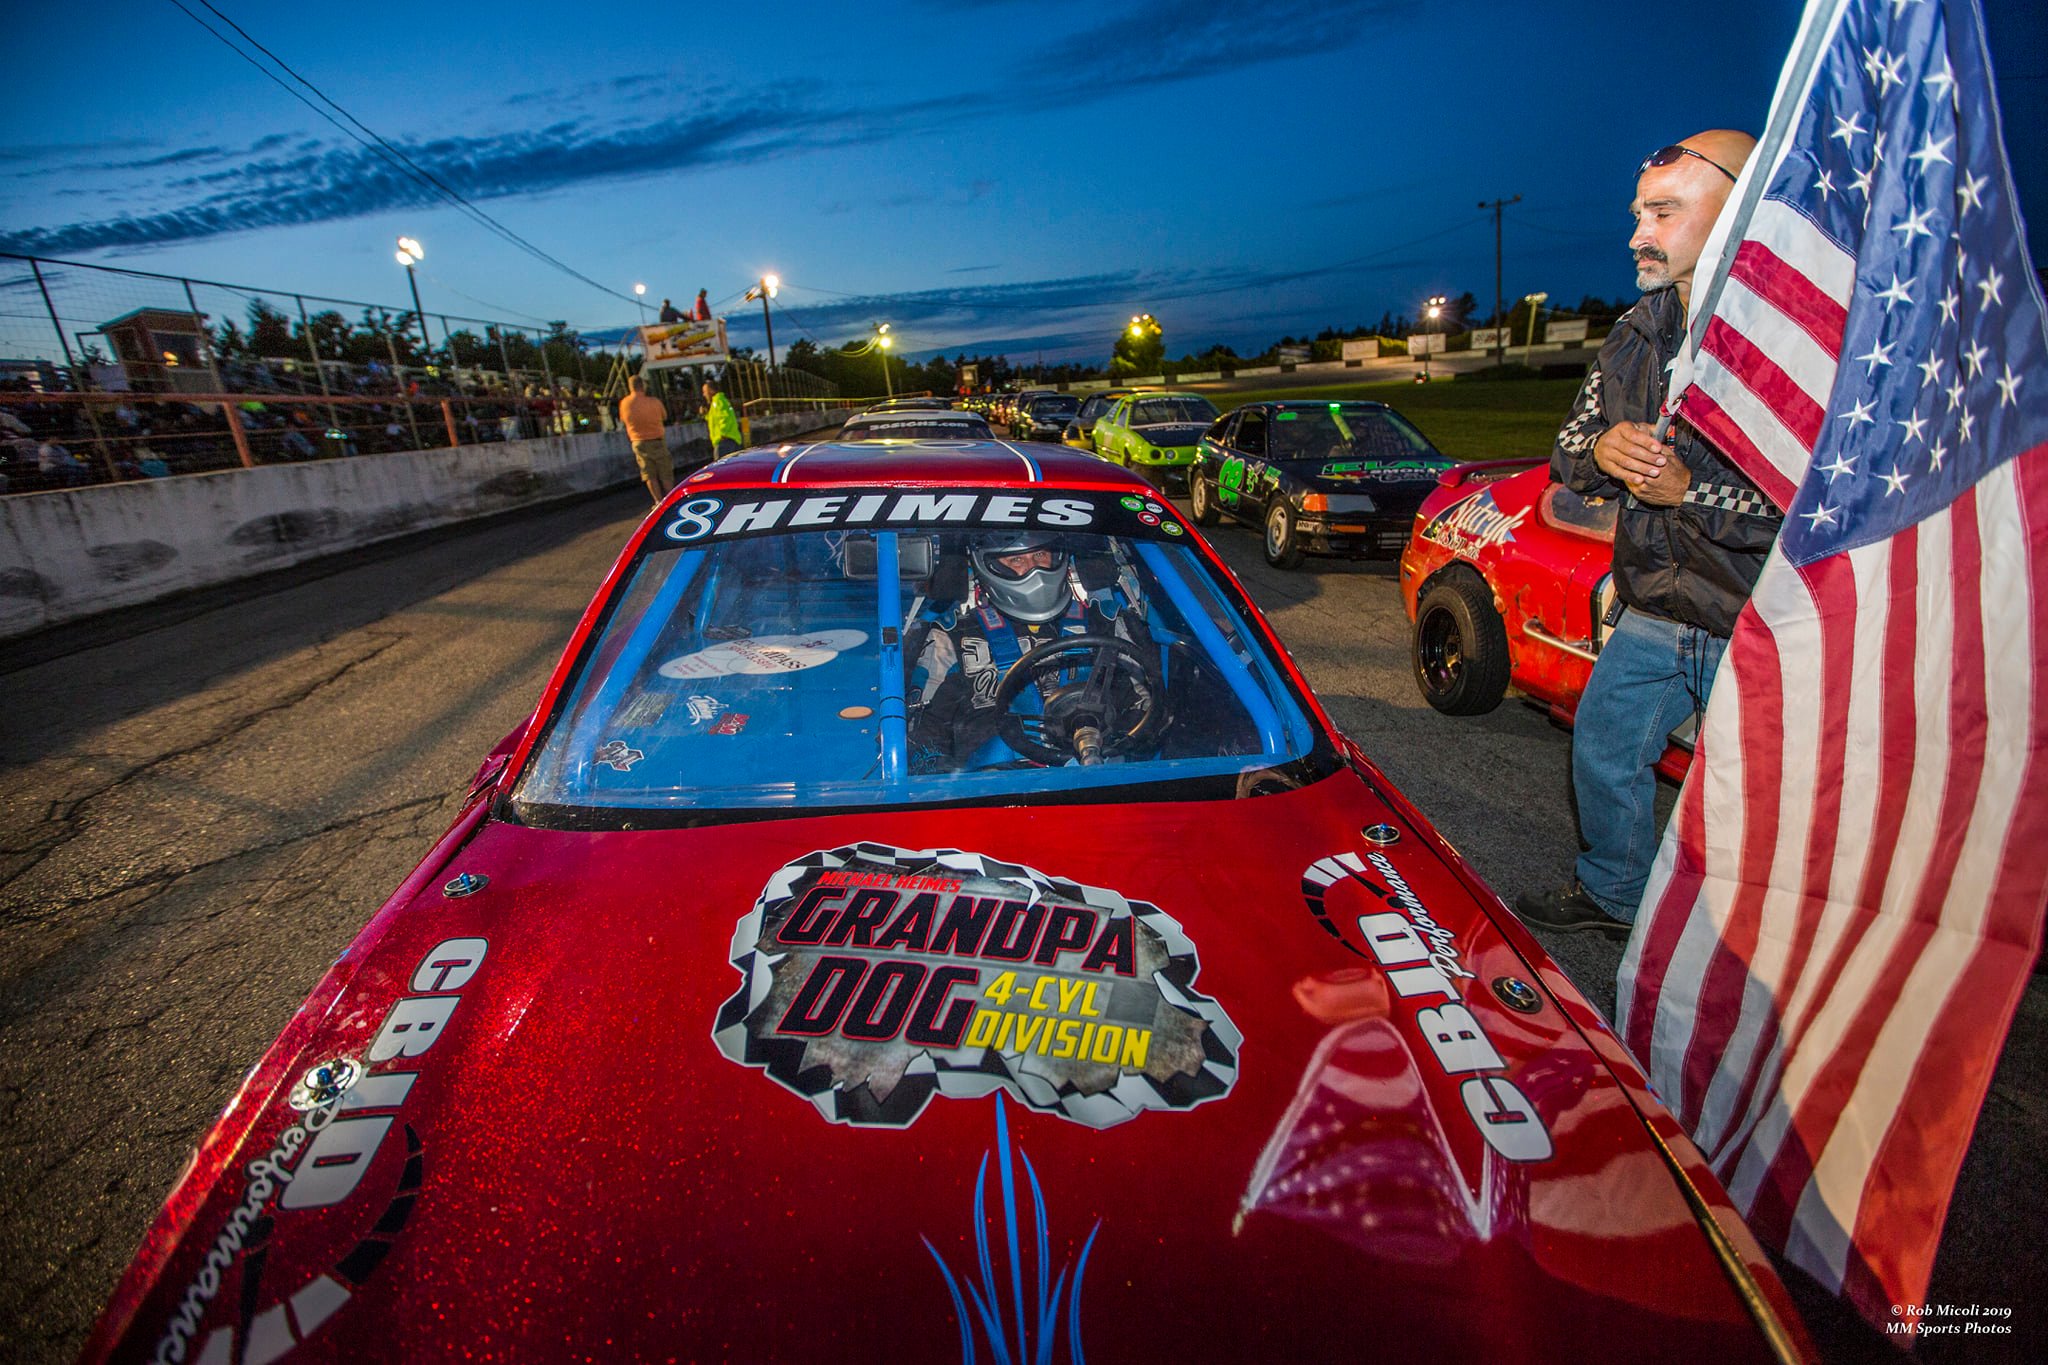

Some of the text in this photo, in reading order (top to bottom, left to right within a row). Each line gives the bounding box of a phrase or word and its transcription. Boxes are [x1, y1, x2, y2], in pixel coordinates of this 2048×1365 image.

[665, 495, 1094, 541] 8 HEIMES
[818, 872, 963, 893] MICHAEL HEIMES
[1365, 851, 1477, 979] Performance
[777, 887, 1135, 976] GRANDPA
[776, 957, 979, 1048] DOG
[984, 972, 1100, 1018] 4-CYL
[966, 1012, 1151, 1067] DIVISION
[148, 1097, 346, 1365] Performanc
